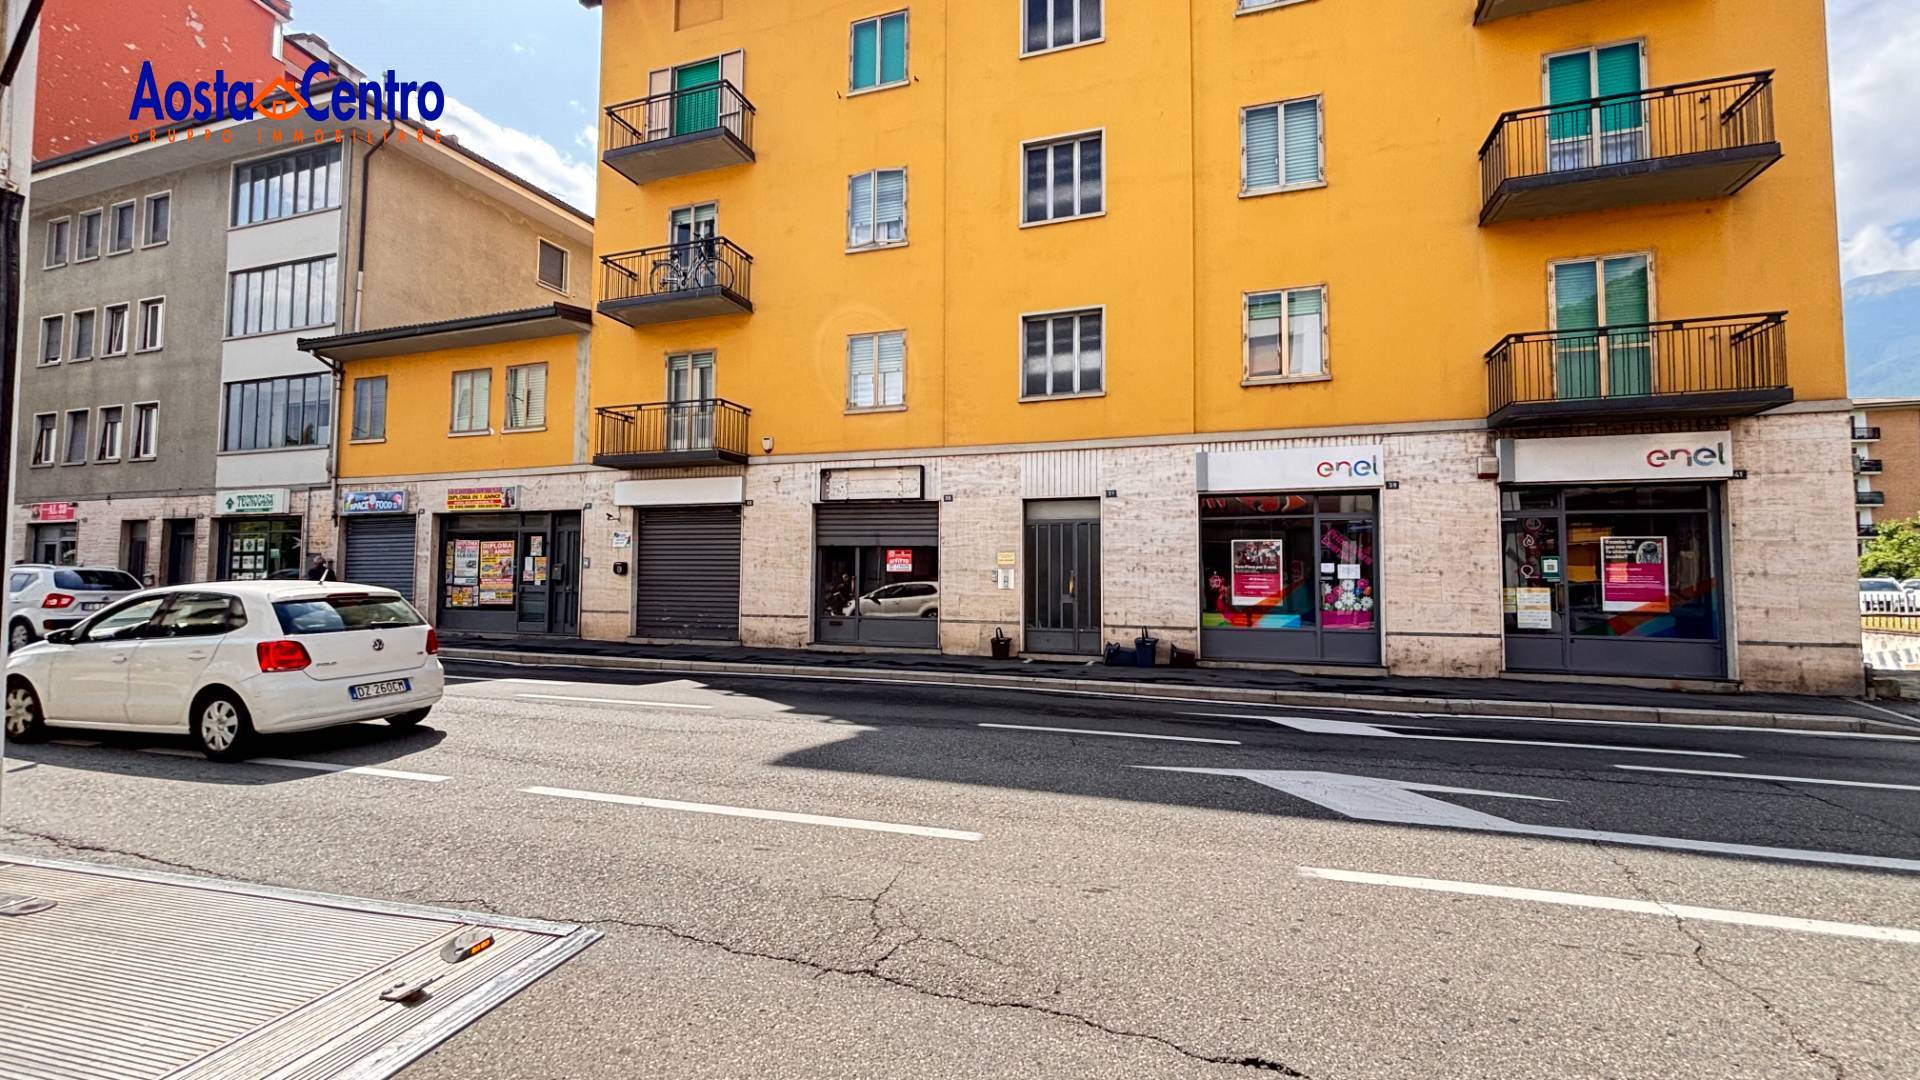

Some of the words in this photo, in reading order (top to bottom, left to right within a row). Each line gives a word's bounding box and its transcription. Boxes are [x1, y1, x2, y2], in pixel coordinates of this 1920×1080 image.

[1317, 454, 1378, 478] enel
[1646, 442, 1725, 468] enel
[357, 686, 373, 698] DZ
[374, 680, 404, 694] 260CM
